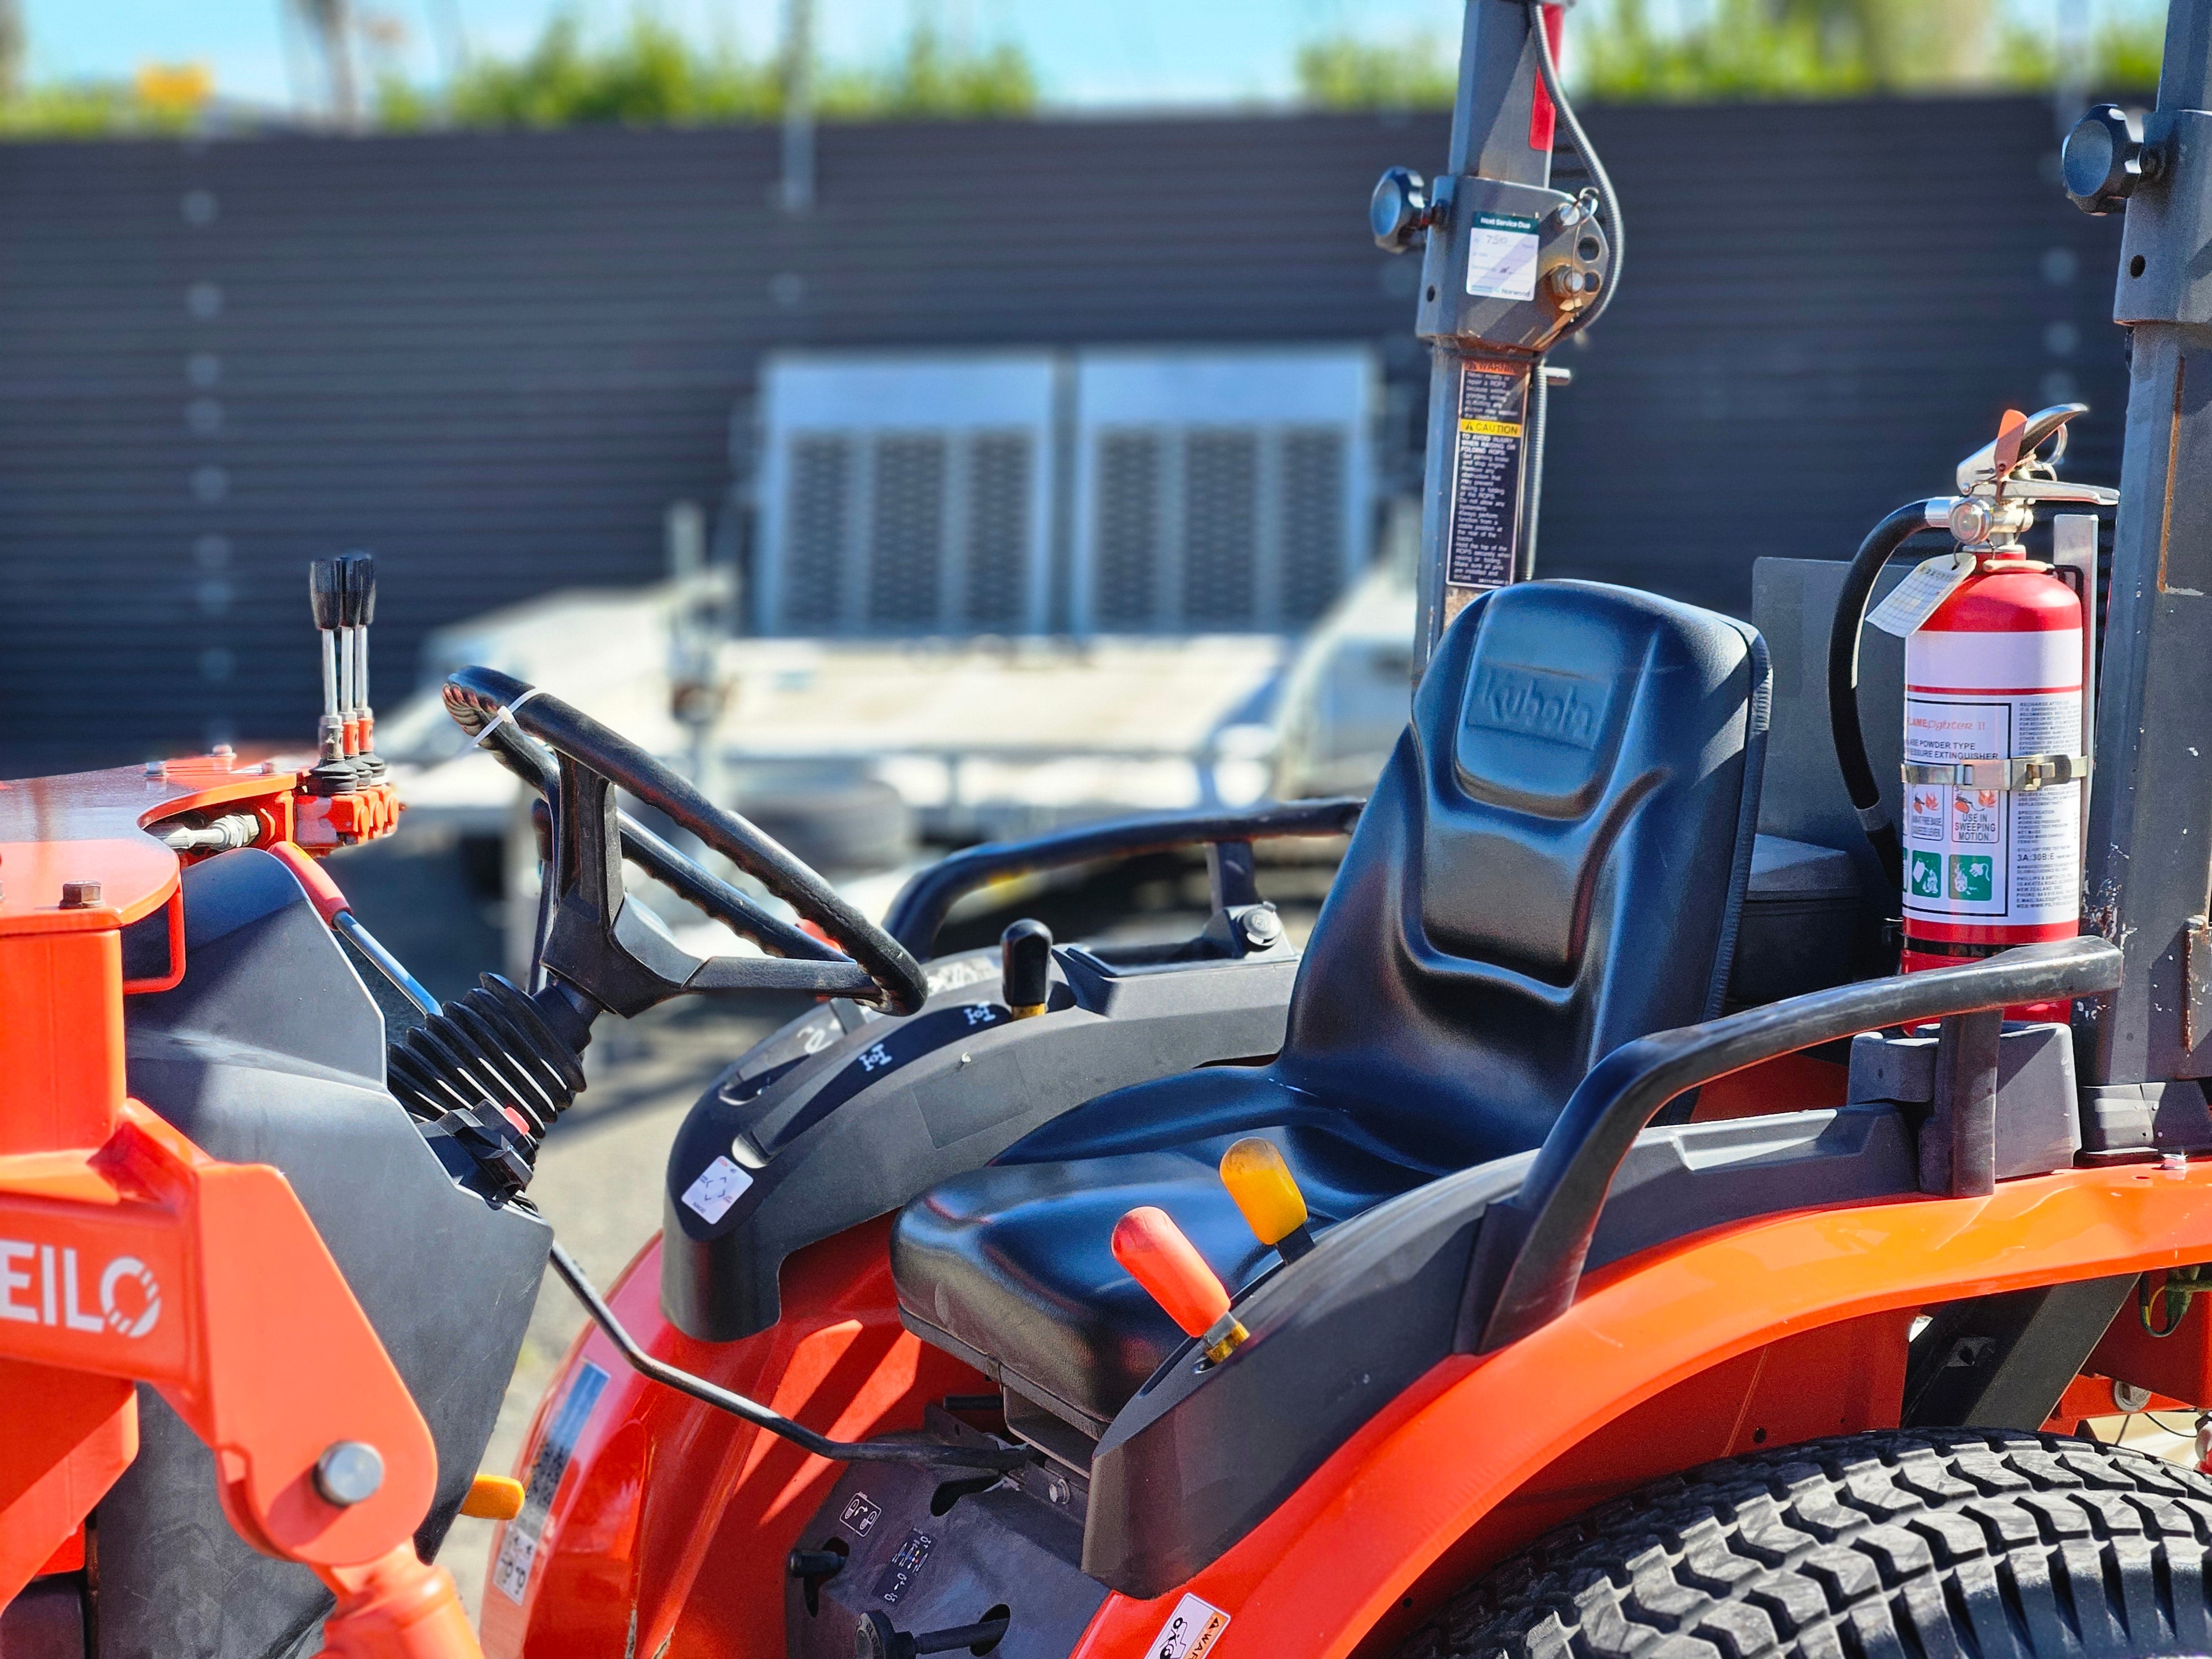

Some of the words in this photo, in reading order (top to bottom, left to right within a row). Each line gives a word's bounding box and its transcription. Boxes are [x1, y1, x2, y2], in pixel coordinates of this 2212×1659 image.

[1476, 423, 1517, 434] CAUTION
[1479, 667, 1593, 739] Kubota
[1919, 740, 1950, 749] POWDER
[1934, 751, 1998, 760] EXTINGUISHER
[1963, 813, 1978, 822] USE
[1980, 814, 1987, 822] IN
[1955, 822, 1995, 832] SWEEPING
